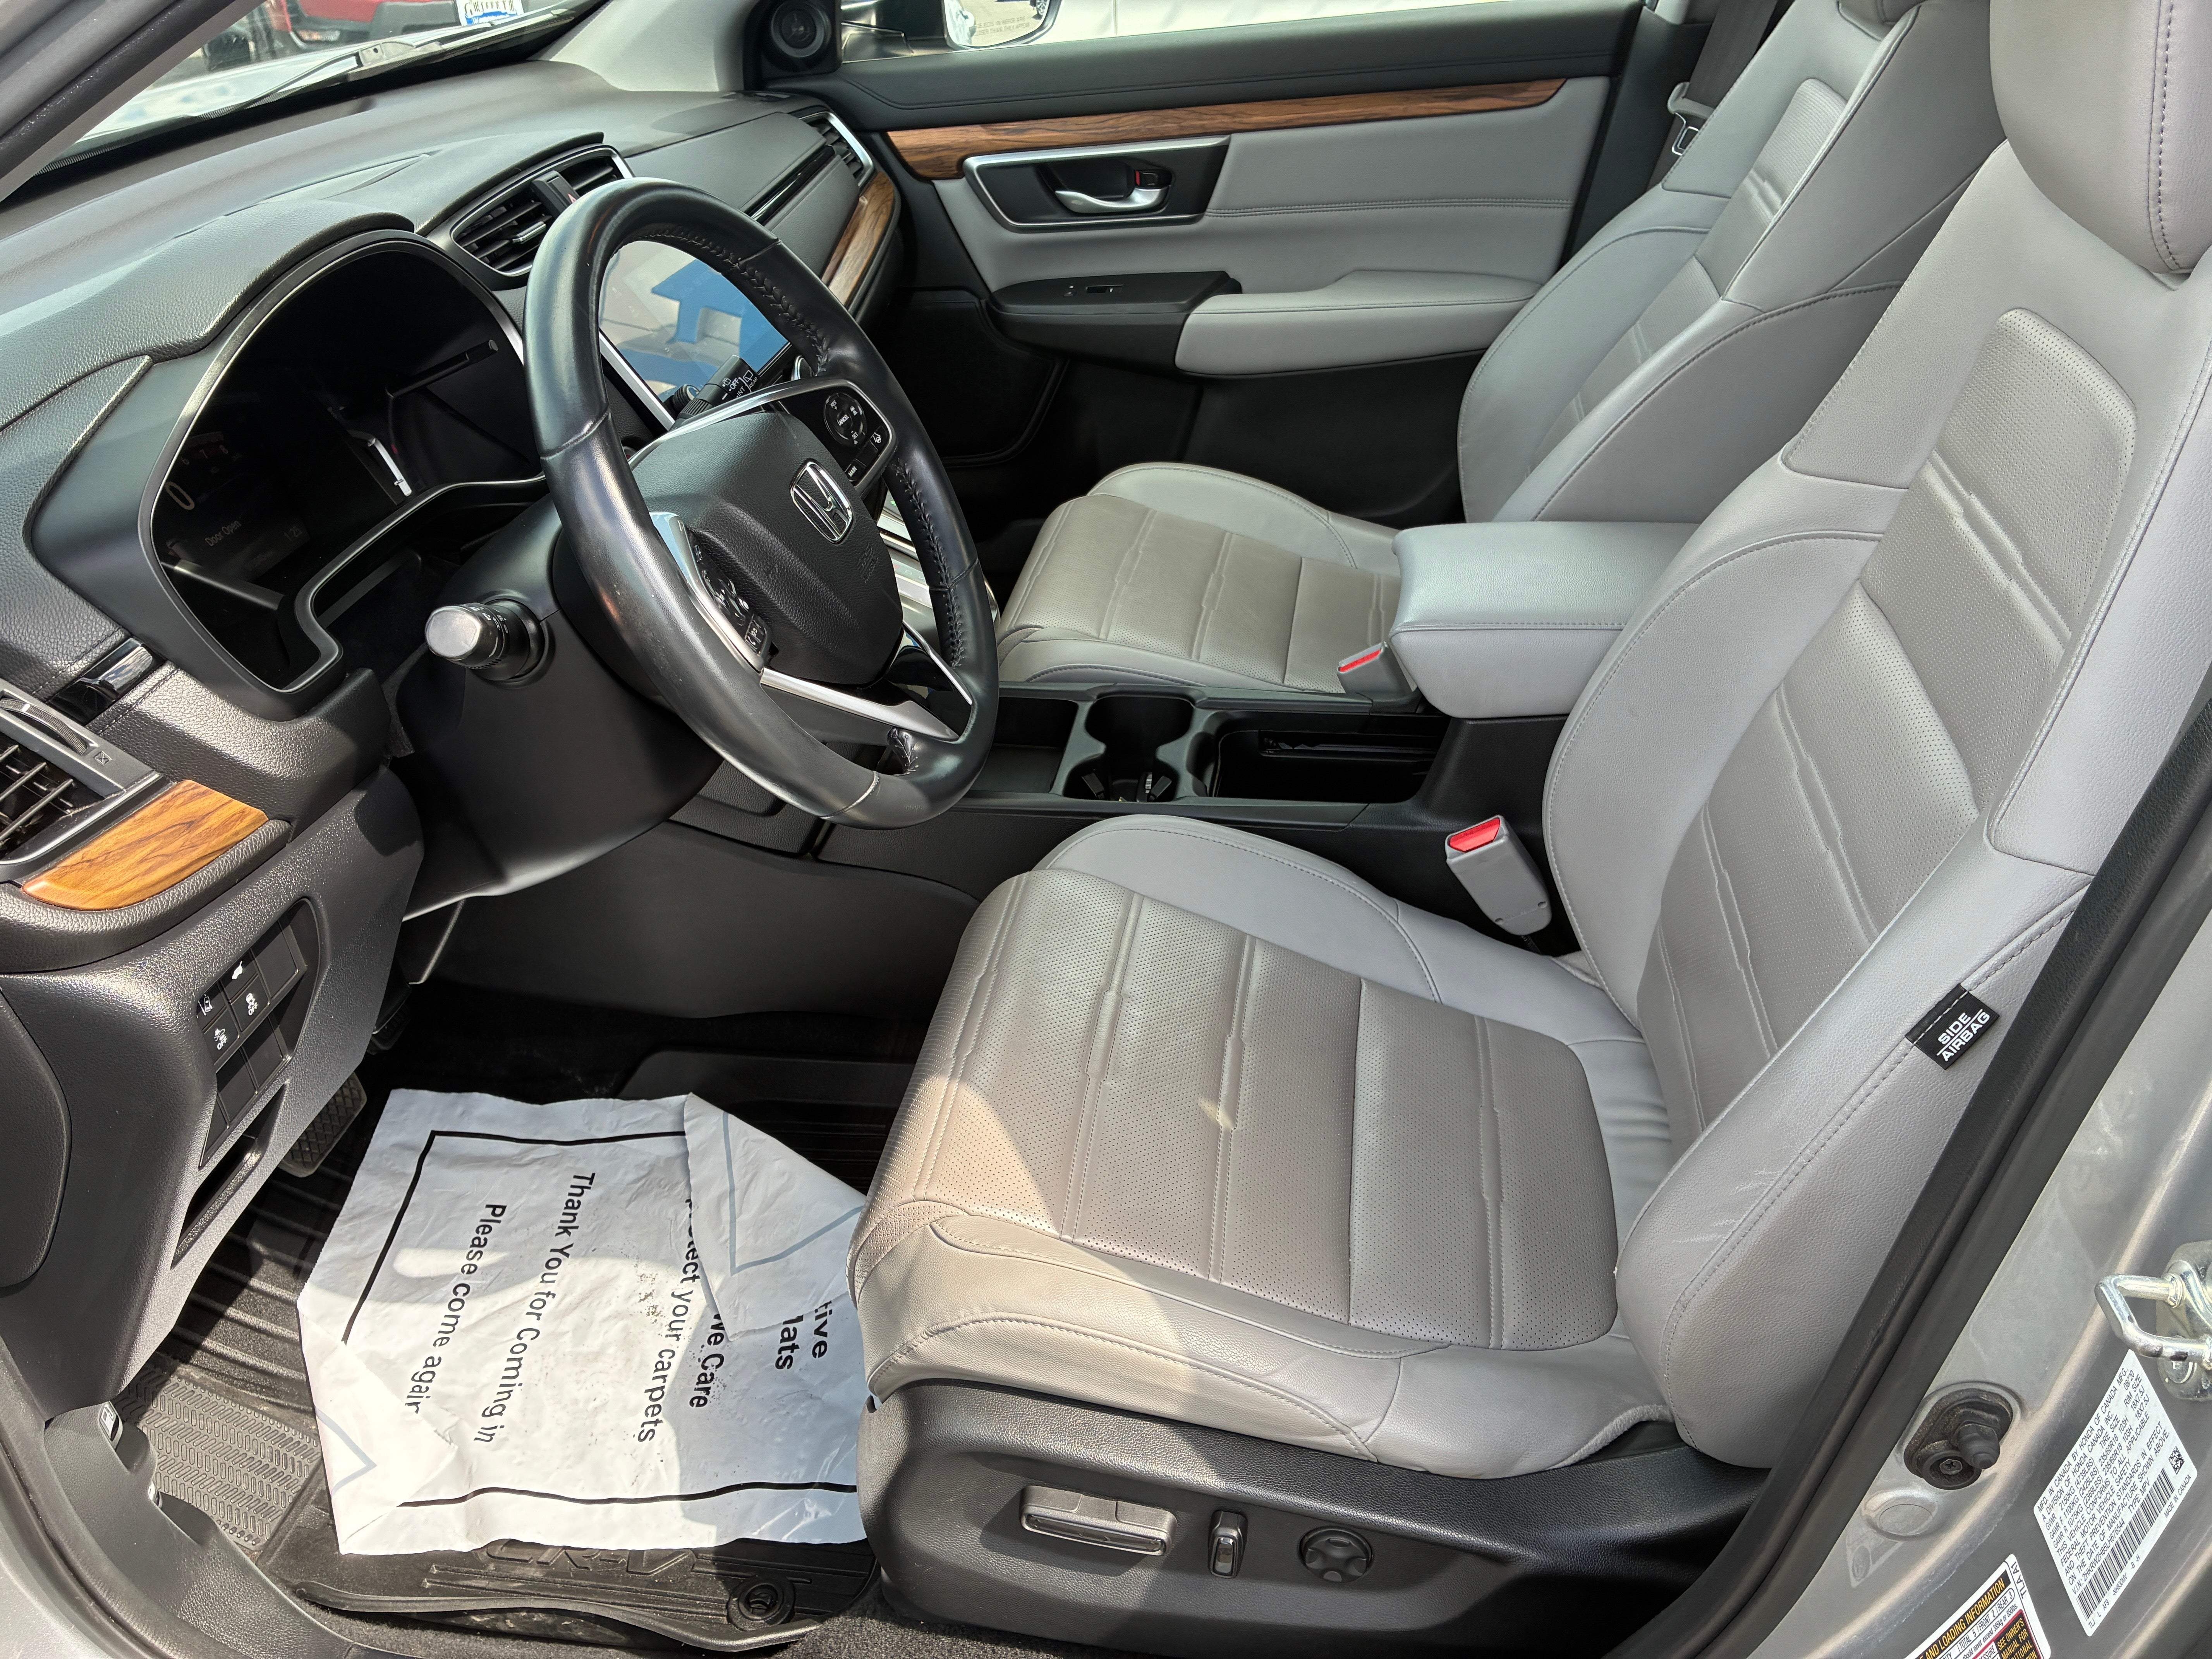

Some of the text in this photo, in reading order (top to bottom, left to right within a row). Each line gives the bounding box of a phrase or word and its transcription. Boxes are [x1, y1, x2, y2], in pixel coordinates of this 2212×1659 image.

[730, 378, 739, 390] OFF
[737, 386, 745, 397] INT
[749, 377, 758, 388] REAR
[848, 466, 857, 477] MAIN
[205, 520, 242, 546] Door Open
[248, 1002, 258, 1016] OFF
[1938, 1012, 1971, 1044] SIDE
[1941, 1011, 1990, 1062] AIRBAG
[217, 1036, 227, 1050] OFF
[460, 1204, 507, 1275] Please
[432, 1283, 471, 1347] come
[474, 1173, 596, 1443] Thank You for Coming in
[665, 1289, 694, 1342] your
[637, 1349, 676, 1443] carpets
[689, 1353, 725, 1408] Care
[2037, 1496, 2049, 1513] MFD.
[2048, 1486, 2054, 1497] IN
[2054, 1460, 2072, 1487] CANADA
[2071, 1448, 2078, 1462] BY
[2078, 1425, 2095, 1451] HONDA
[2094, 1413, 2100, 1425] OF
[2101, 1386, 2118, 1414] CANADA
[2042, 1514, 2047, 1522] A
[2045, 1486, 2064, 1515] DIVISION
[2064, 1475, 2071, 1487] OF
[2071, 1453, 2088, 1477] HONDA
[2087, 1425, 2105, 1453] CANADA
[2045, 1374, 2142, 1530] GVWR 2150KG (4739LBS) TIRE SIZE RIM SIZE
[2049, 1385, 2145, 1540] GAWR F 1100KG (2425LBS) 235/60R18 103H 18X7.5J
[2053, 1394, 2150, 1548] GAWR R 1075KG (2369LBS) 235/60R18 103H 18X7.5J
[2056, 1411, 2150, 1556] THIS VEHICLE CONFORMS TO ALL APPLICABLE
[2065, 1421, 2162, 1577] AND THEFT PREVENTION STANDARDS IN EFFECT
[2068, 1429, 2170, 1585] ON THE DATE OF MANUFACTURE SHOWN ABOVE.
[2164, 1501, 2174, 1518] MADE
[2173, 1494, 2178, 1503] IN
[2178, 1474, 2191, 1496] CANADA
[2060, 1458, 2131, 1567] FEDERAL MOTOR VEHICLE SAFETY
[2082, 1518, 2125, 1582] 2HKRW2H85LH676544
[2128, 1494, 2142, 1513] TYPE:
[2139, 1477, 2150, 1496] MPV
[2011, 1561, 2027, 1599] TLA A1
[1925, 1577, 2005, 1659] AND LOADING INFORMATION
[1959, 1635, 1972, 1650] TOTAL
[1972, 1629, 1976, 1638] 5
[1978, 1614, 1990, 1632] FRONT
[1992, 1610, 1995, 1618] 2
[1997, 1596, 2007, 1611] REAR
[1997, 1618, 2024, 1650] SEE OWNER'S
[2001, 1628, 2029, 1659] MANUAL FOR
